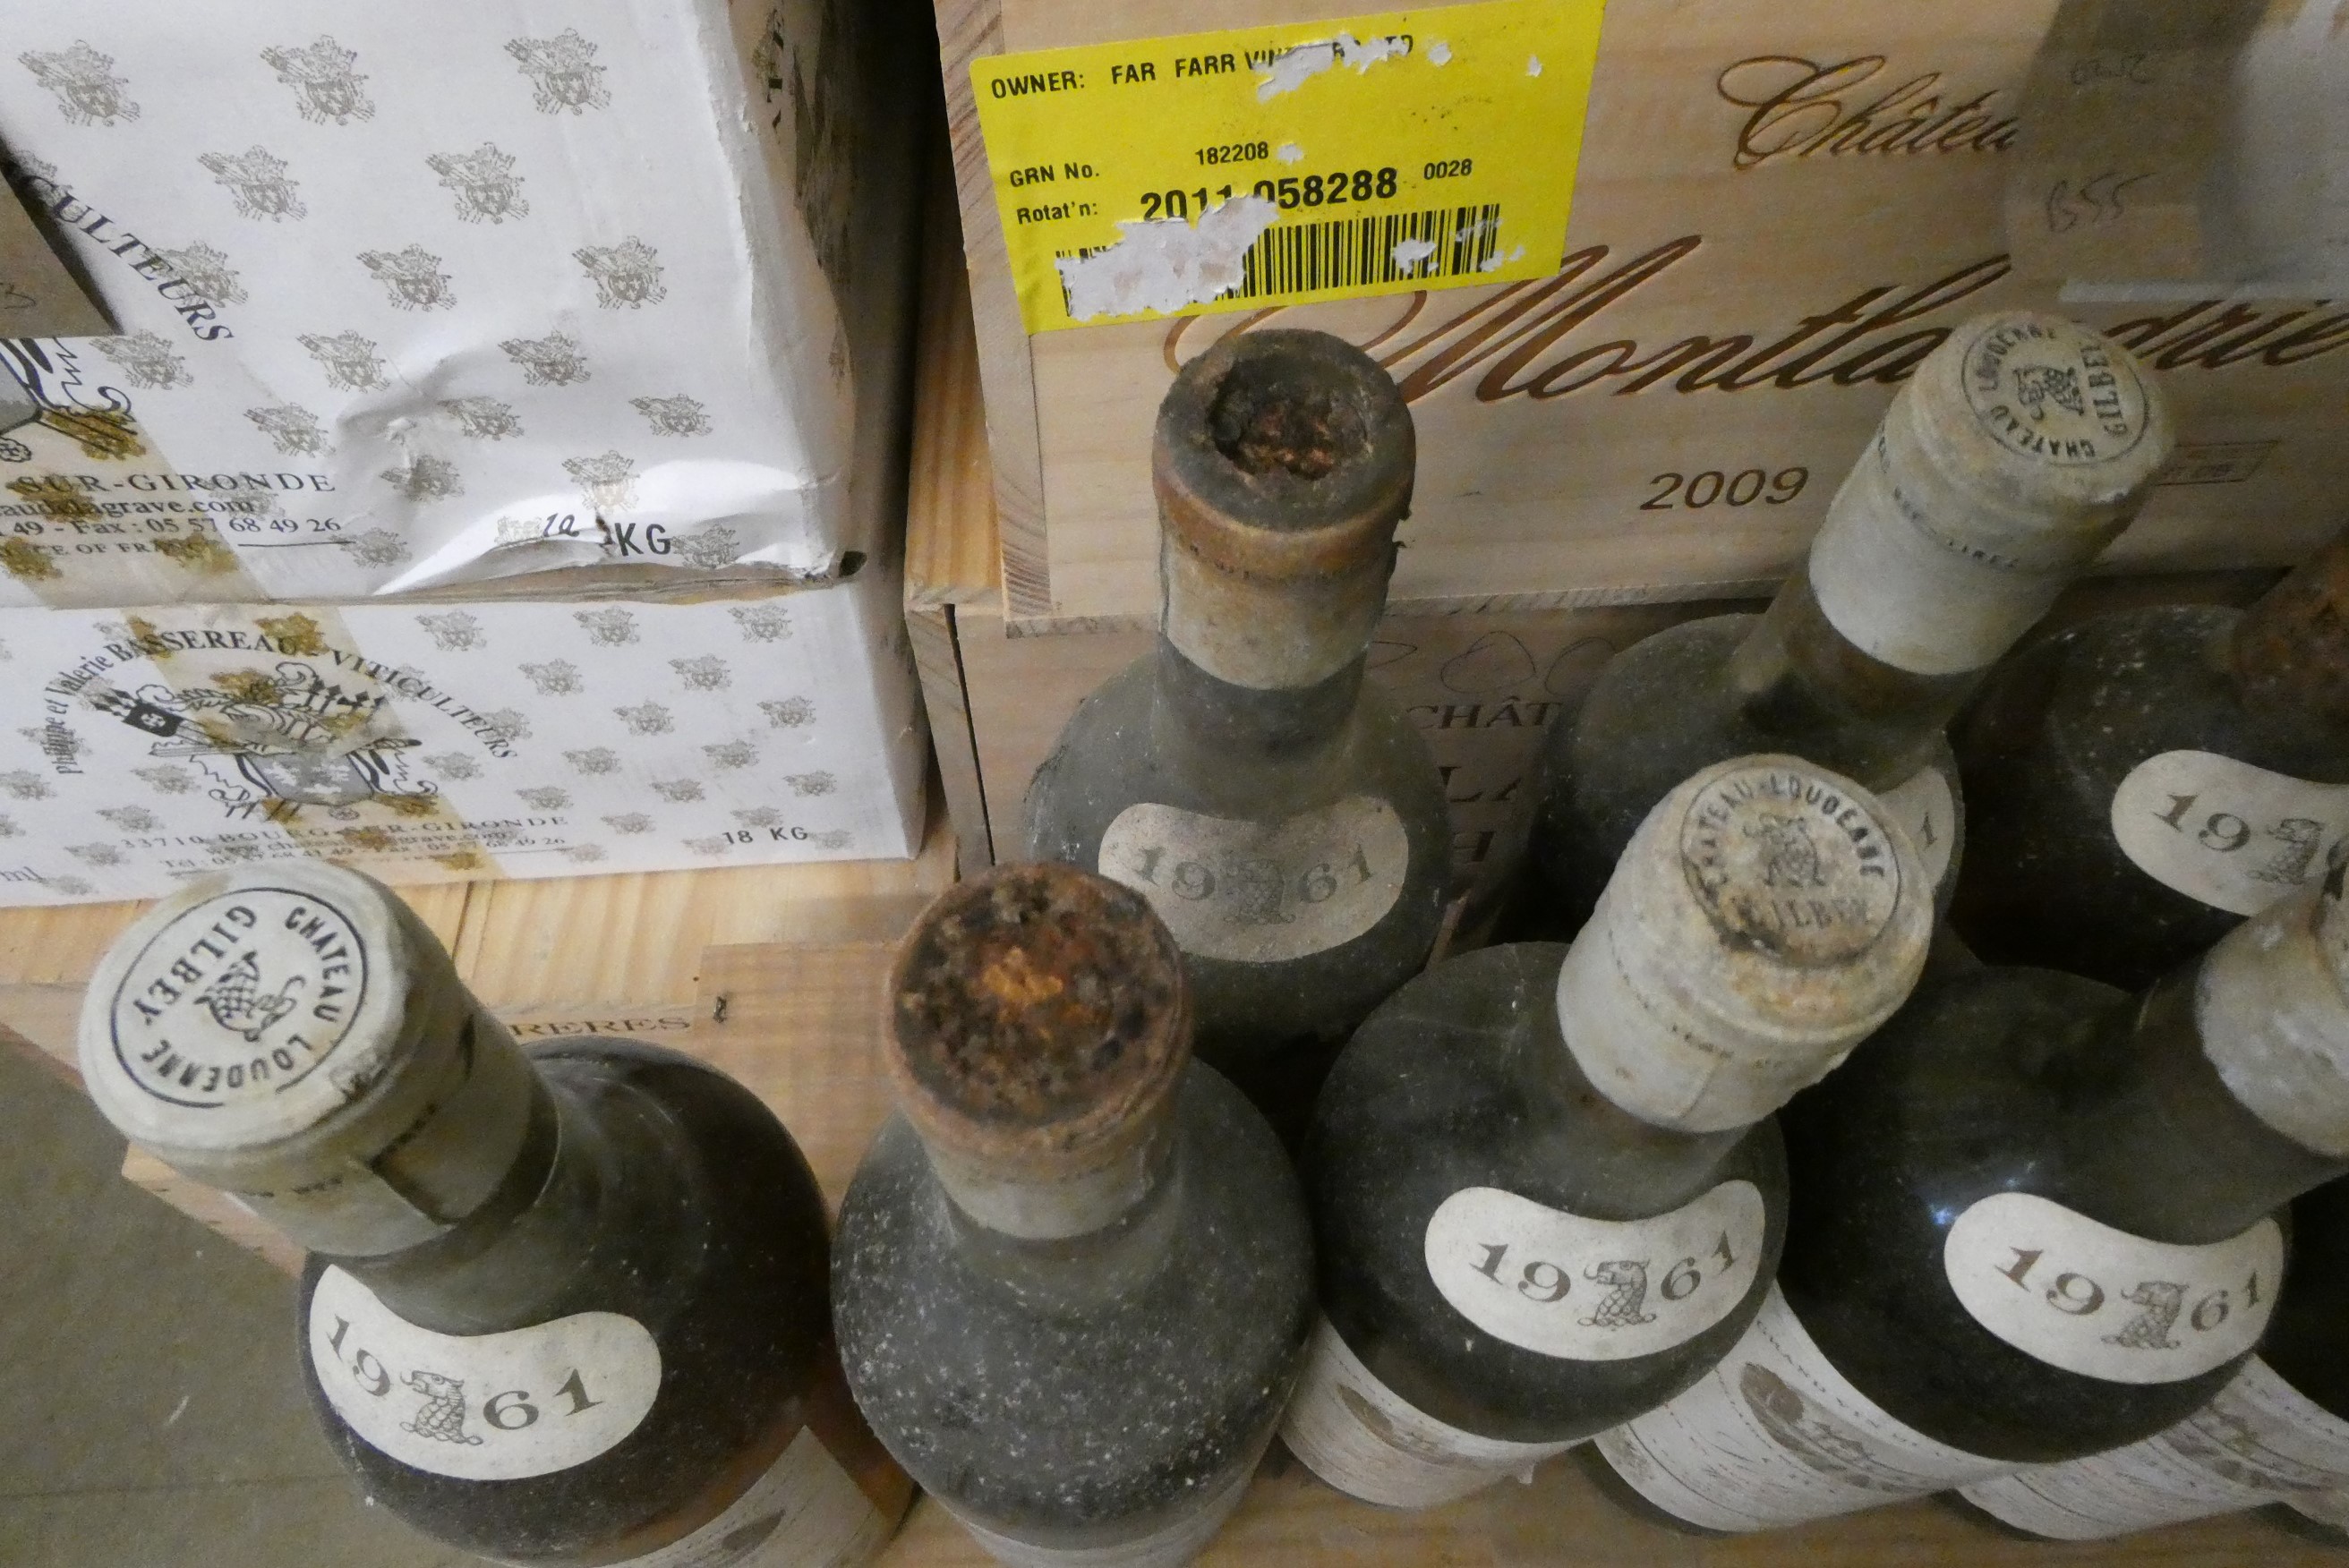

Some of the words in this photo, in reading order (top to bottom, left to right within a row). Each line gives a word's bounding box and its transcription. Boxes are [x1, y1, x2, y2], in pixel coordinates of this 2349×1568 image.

[991, 70, 1085, 98] OWNER:
[1112, 62, 1156, 85] FAR
[1175, 53, 1235, 78] FARR
[1010, 165, 1055, 188] GRN
[1064, 162, 1099, 179] No.
[1195, 141, 1268, 166] 182208
[1017, 201, 1098, 225] Rotat'n:
[1423, 158, 1473, 180] 0028
[1640, 467, 1809, 510] 2009
[14, 522, 44, 535] 49
[71, 519, 125, 534] Fax
[146, 518, 179, 533] 05
[188, 517, 217, 533] 57
[229, 516, 261, 533] 68
[270, 519, 298, 533] 49
[306, 517, 341, 532] 26
[614, 523, 671, 557] KG
[332, 650, 517, 758] VITICULTEURS
[722, 830, 754, 844] 18
[770, 826, 807, 841] KG
[133, 904, 258, 1026] GILBEY
[285, 906, 351, 1023] CHATEAU
[141, 1033, 313, 1093] LOUDENNE
